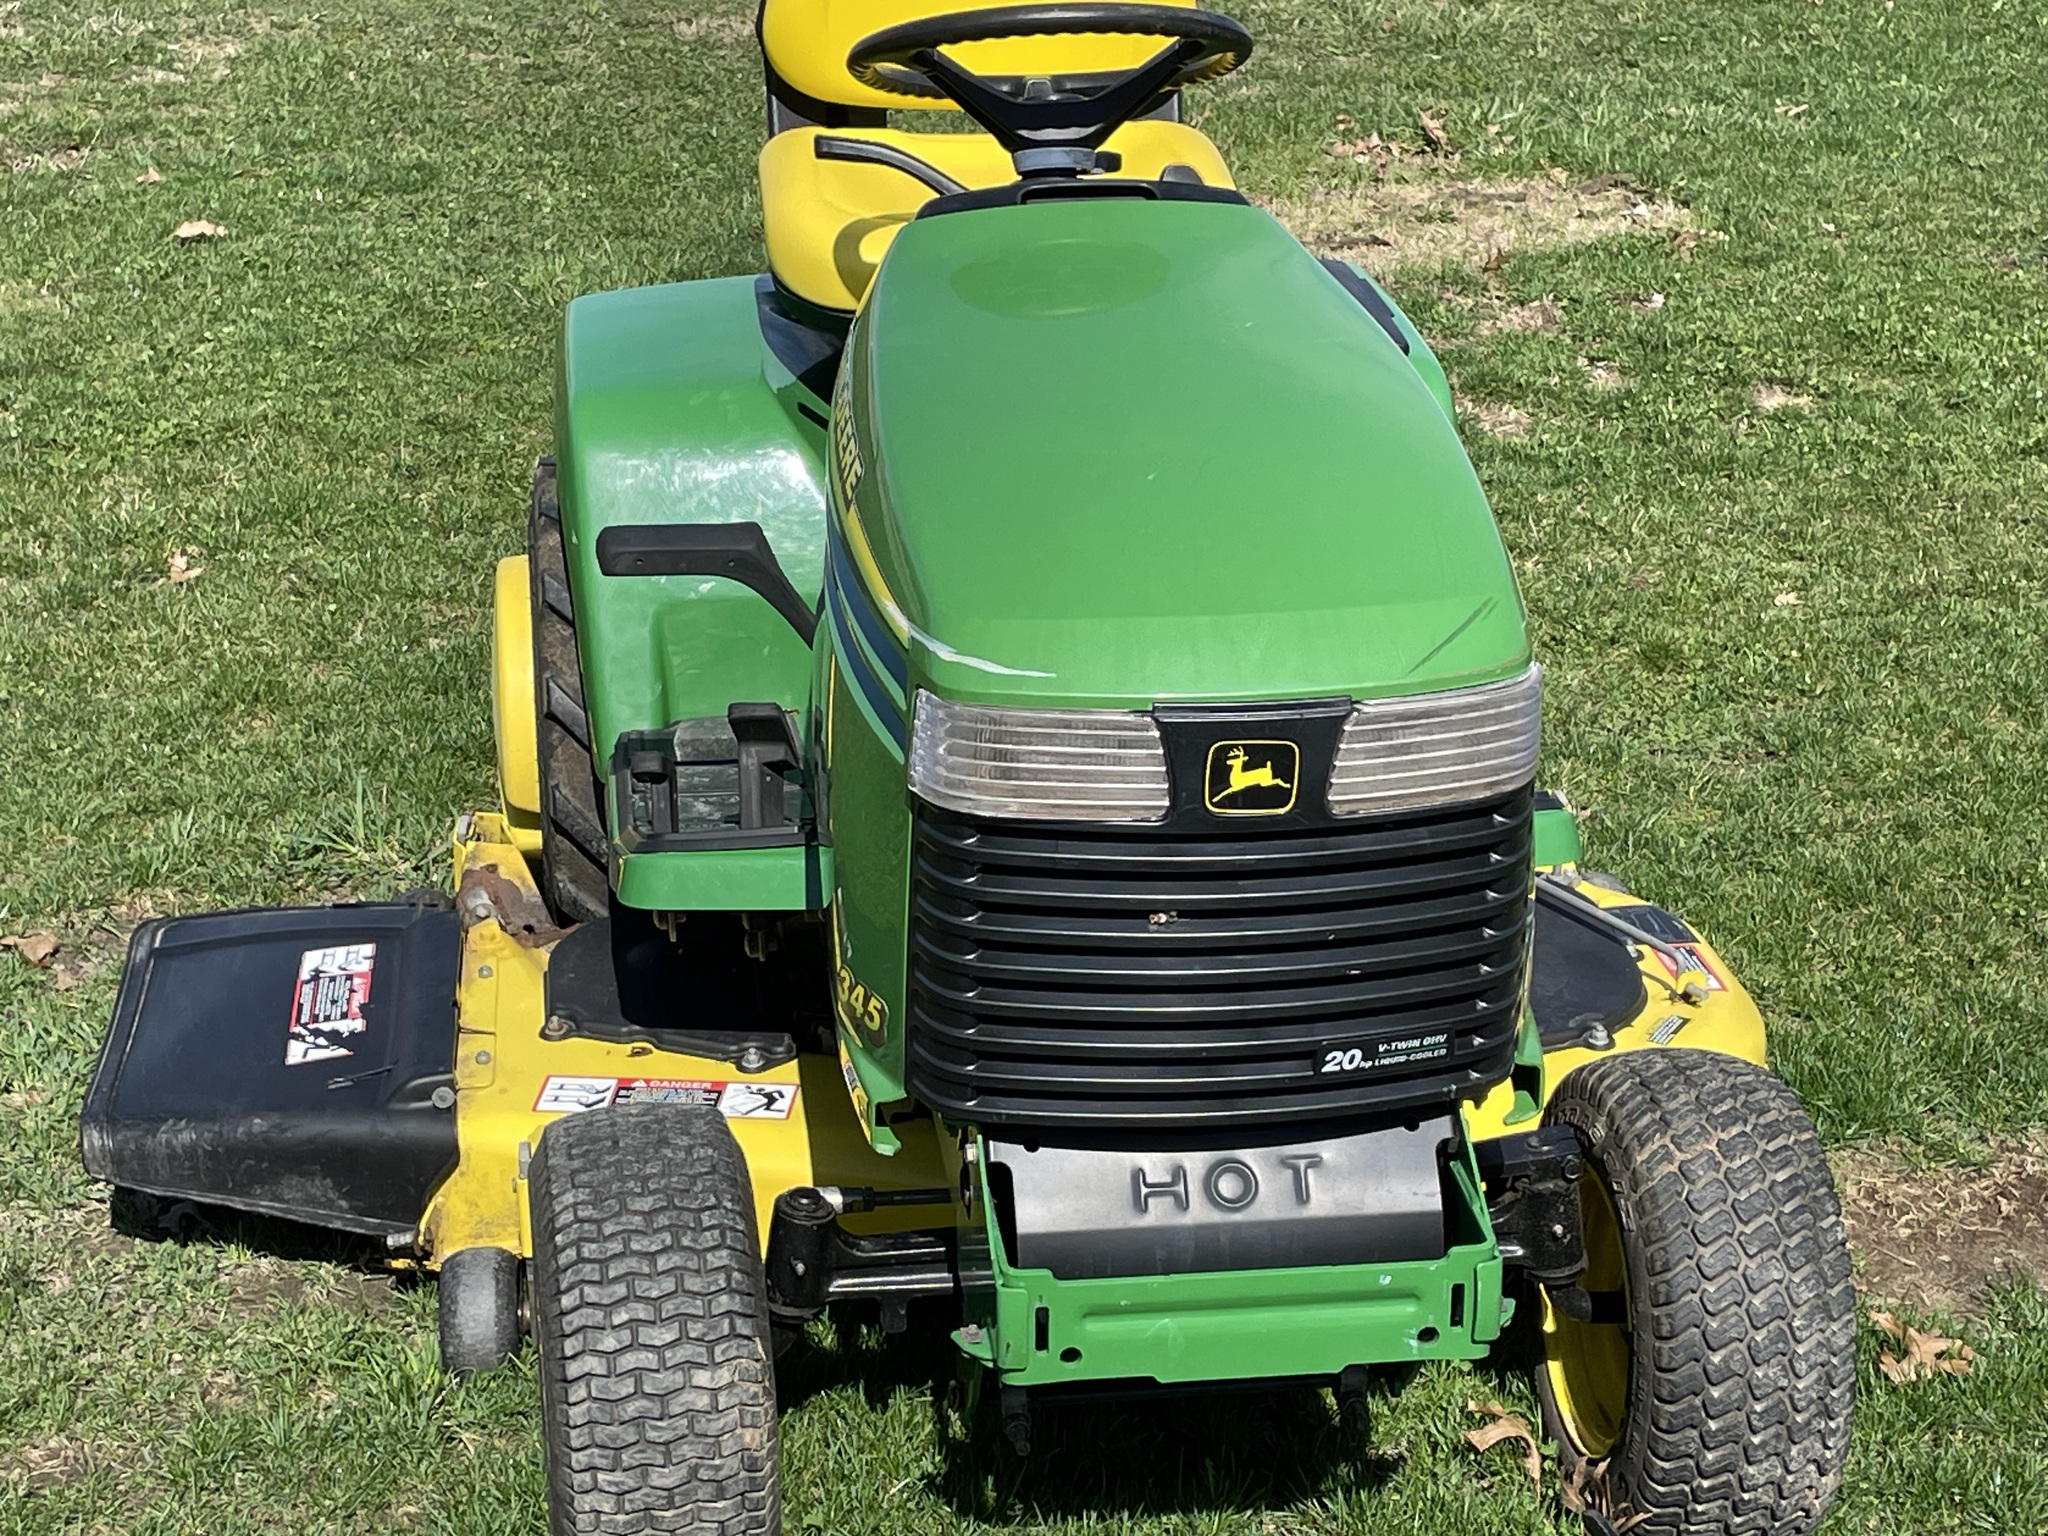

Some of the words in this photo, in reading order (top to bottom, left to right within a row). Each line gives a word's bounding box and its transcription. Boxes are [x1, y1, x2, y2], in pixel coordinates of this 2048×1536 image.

[837, 968, 882, 1031] 345
[1379, 1038, 1421, 1053] V-TWIN
[1423, 1034, 1448, 1047] OHV
[1375, 1048, 1447, 1067] LIQUID-COOLED
[649, 1080, 712, 1089] DANGER
[1131, 1152, 1323, 1214] HOT
